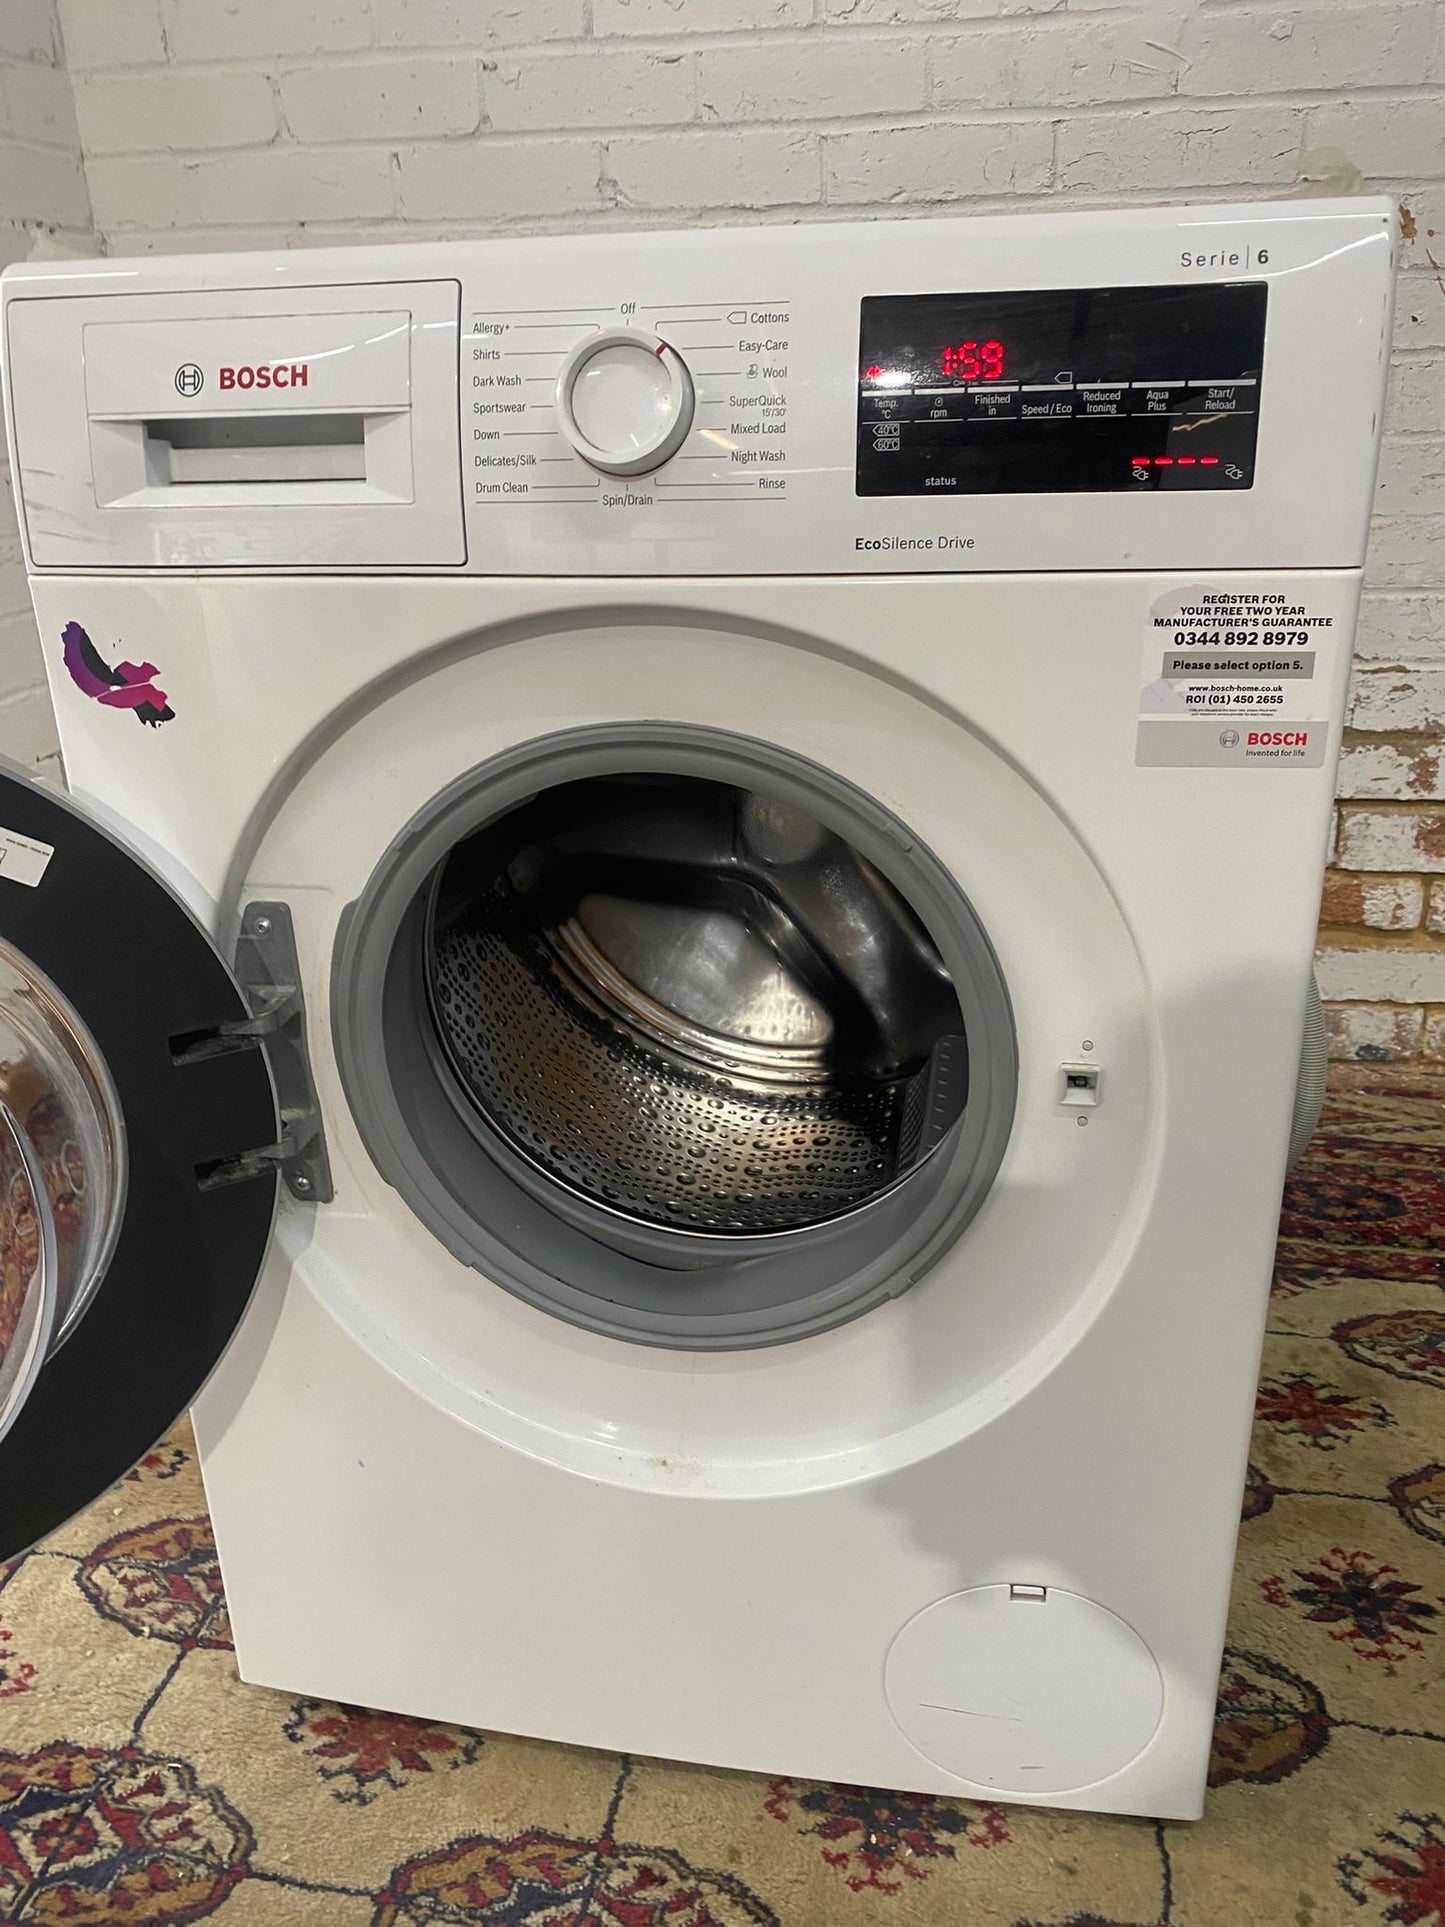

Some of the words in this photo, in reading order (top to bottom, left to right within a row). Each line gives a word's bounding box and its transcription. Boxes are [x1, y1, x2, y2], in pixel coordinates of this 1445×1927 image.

[1180, 251, 1240, 268] Serie
[1258, 249, 1270, 264] 6
[620, 302, 636, 314] Off
[750, 312, 790, 324] Cottons
[472, 321, 510, 335] Allergy+
[738, 339, 789, 353] Easy-Care
[472, 348, 501, 361] Shirts
[219, 364, 308, 390] BOSCH
[763, 367, 788, 378] Wool
[473, 376, 494, 387] Dark
[495, 374, 522, 387] Wash
[1082, 391, 1121, 401] Reduced
[1145, 389, 1169, 401] Aqua
[1207, 387, 1235, 399] Start/
[729, 394, 787, 409] SuperQuick
[873, 398, 899, 409] Temp.
[974, 394, 1011, 405] Finished
[1204, 400, 1237, 410] Reload
[472, 401, 526, 415] Sportswear
[988, 405, 997, 416] in
[1021, 404, 1050, 415] Speed
[1055, 404, 1073, 414] Eco
[1086, 402, 1117, 414] Ironing
[1147, 401, 1167, 411] Plus
[881, 409, 892, 419] °C
[929, 408, 948, 419] rpm
[730, 422, 759, 434] Mixed
[761, 422, 787, 433] Load
[878, 424, 898, 435] 40°C
[473, 429, 500, 441] Down
[878, 439, 898, 449] 60°C
[473, 454, 538, 468] Delicates/Silk
[731, 450, 757, 463] Night
[758, 450, 786, 462] Wash
[758, 477, 786, 489] Rinse
[925, 476, 957, 486] status
[475, 482, 502, 494] Drum
[502, 482, 529, 494] Clean
[602, 493, 654, 507] Spin/Drain
[854, 537, 934, 551] EcoSilence
[937, 535, 976, 549] Drive
[1202, 594, 1260, 604] REGISTER
[1261, 594, 1285, 604] FOR
[1180, 606, 1212, 616] YOUR
[1213, 606, 1243, 616] FREE
[1245, 606, 1273, 616] TWO
[1274, 606, 1306, 616] YEAR
[1153, 618, 1260, 628] MANUFACTURER'S
[1261, 617, 1333, 628] GUARANTEE
[1173, 631, 1221, 646] 0344
[1224, 631, 1259, 646] 892
[1262, 631, 1309, 646] 8979
[1172, 660, 1212, 671] Please
[1213, 660, 1250, 671] select
[1251, 660, 1290, 671] option
[1293, 661, 1303, 670] 5.
[1185, 695, 1206, 704] ROI
[1208, 695, 1231, 706] (01)
[1232, 695, 1254, 704] 450
[1255, 695, 1284, 704] 2655
[1246, 732, 1308, 747] BOSCH
[1245, 749, 1280, 758] Invented
[1281, 749, 1292, 758] for
[1292, 749, 1306, 758] life
